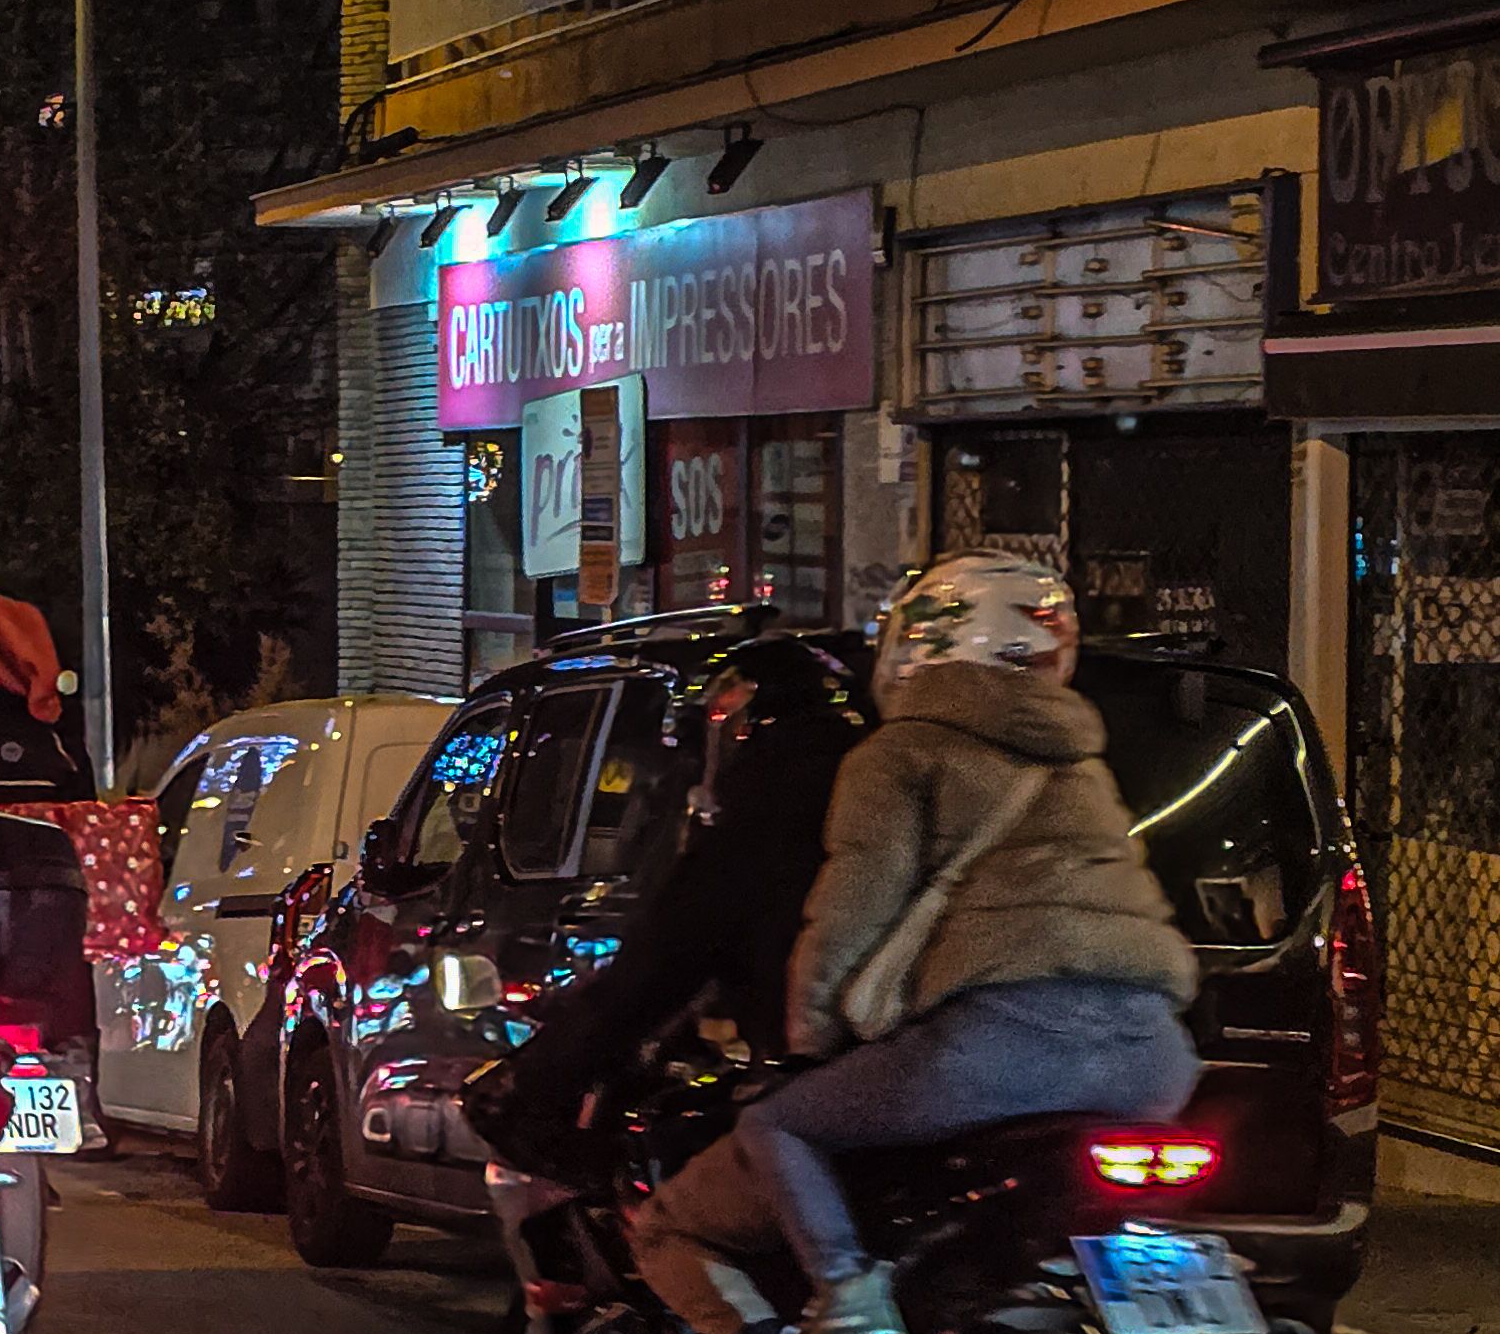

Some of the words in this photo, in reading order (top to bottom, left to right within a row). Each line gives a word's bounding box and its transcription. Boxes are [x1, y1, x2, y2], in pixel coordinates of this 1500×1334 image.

[448, 287, 585, 390] CARTUTXOS
[629, 248, 848, 371] IMPRESSORES
[670, 452, 724, 541] SOS
[8, 1112, 59, 1139] NDR
[11, 1084, 72, 1111] 132
